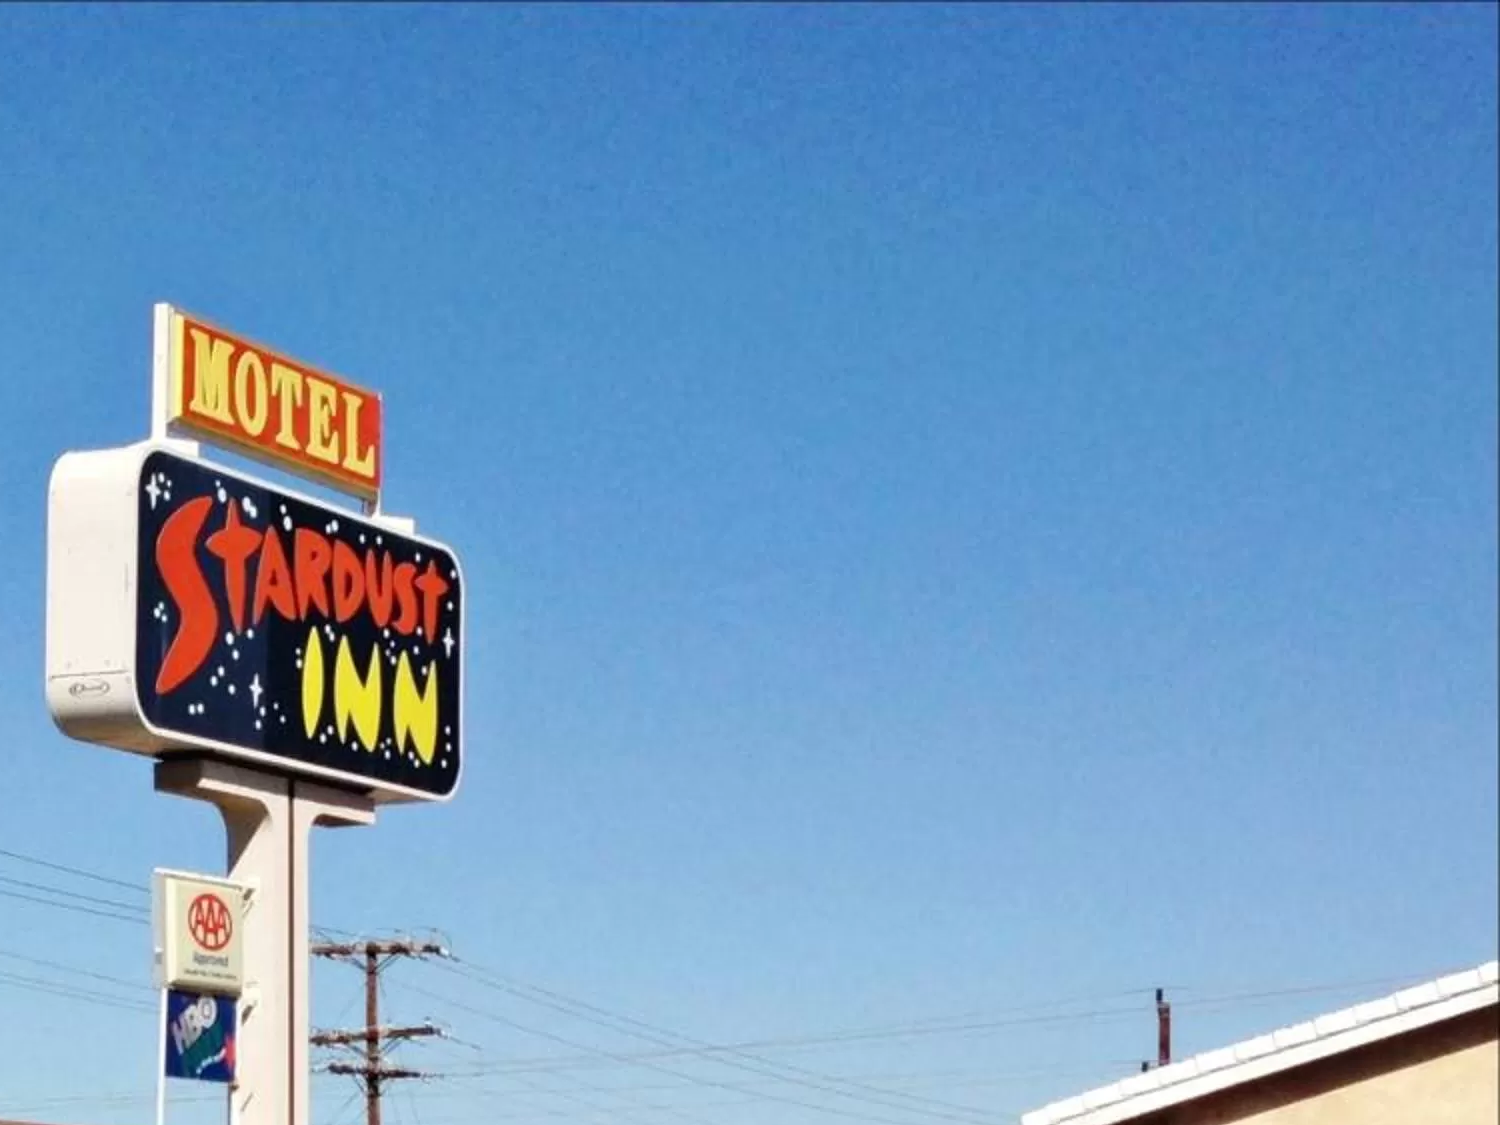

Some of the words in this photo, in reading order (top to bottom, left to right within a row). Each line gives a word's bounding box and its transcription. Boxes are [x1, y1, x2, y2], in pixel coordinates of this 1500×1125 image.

[190, 327, 376, 479] MOTEL
[155, 496, 449, 696] STARDUST
[302, 626, 438, 765] INN
[192, 895, 229, 948] AAA
[171, 997, 218, 1055] HBO
